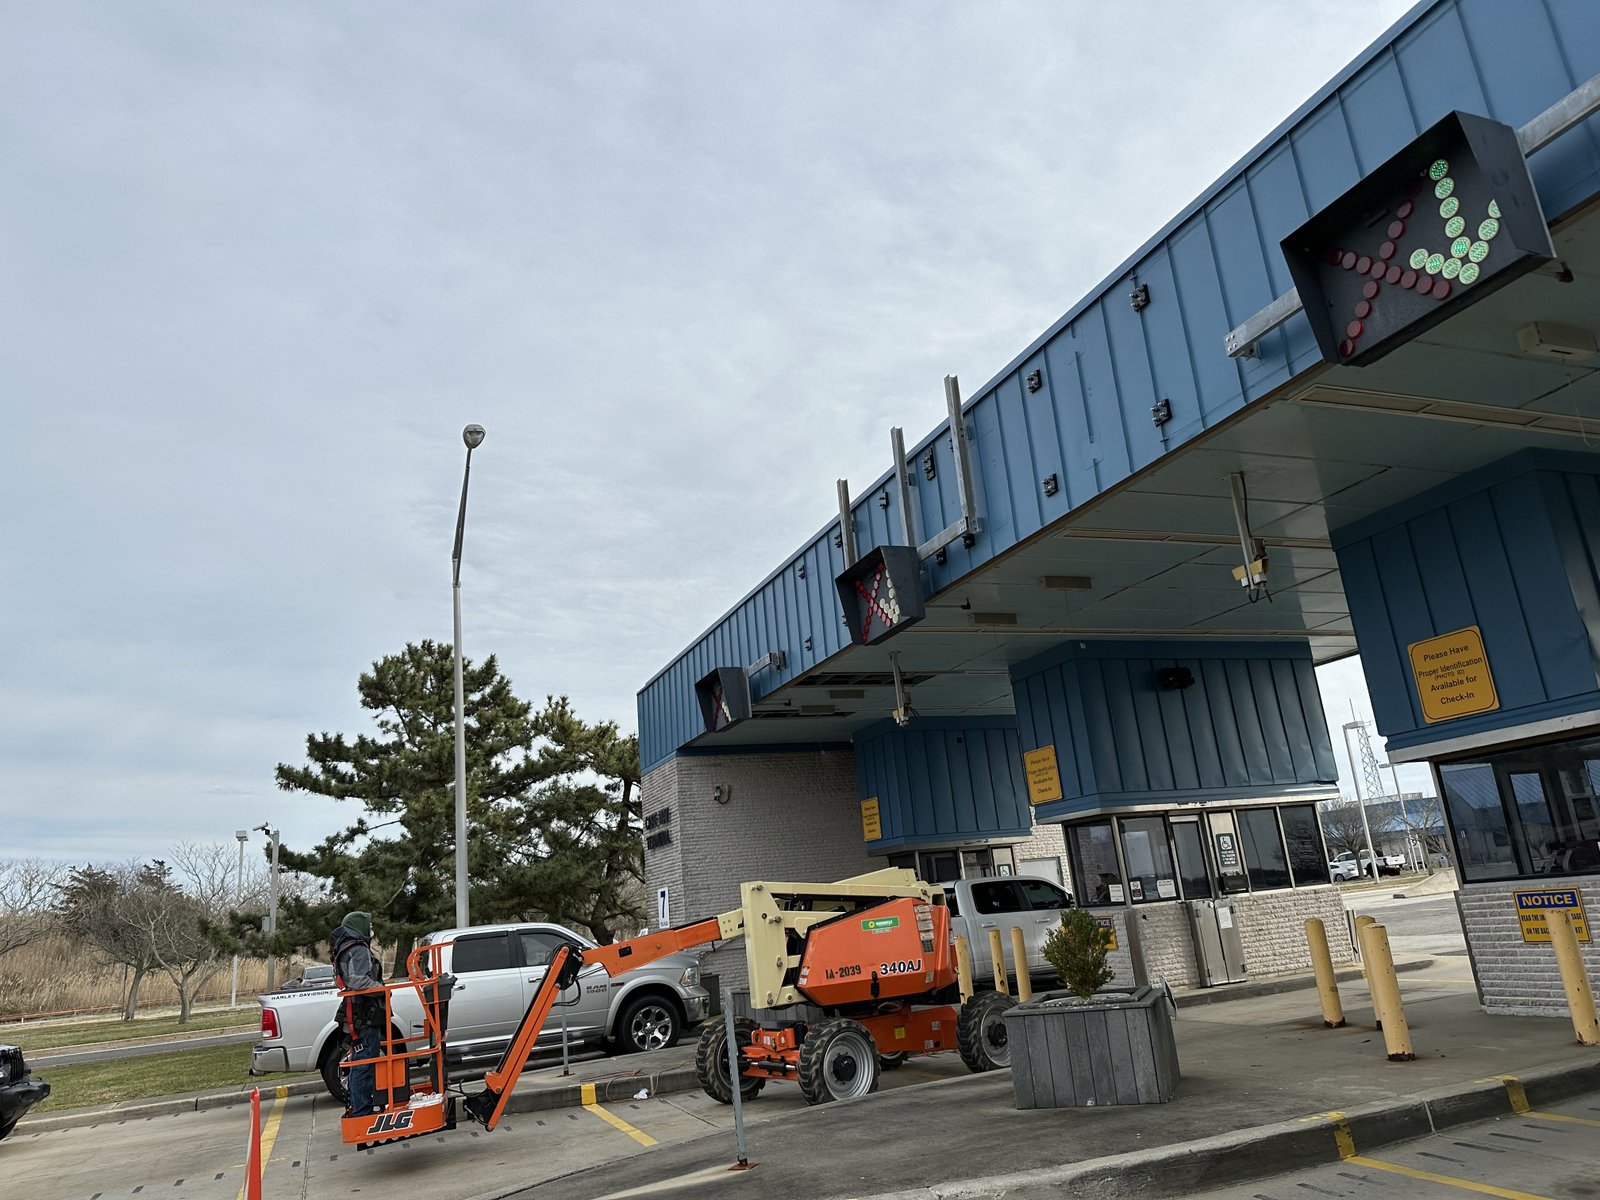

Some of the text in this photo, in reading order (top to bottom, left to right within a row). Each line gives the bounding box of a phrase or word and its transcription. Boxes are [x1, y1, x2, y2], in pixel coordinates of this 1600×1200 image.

[1423, 645, 1469, 661] Please Have
[1418, 657, 1483, 678] Proper Identification
[1430, 675, 1477, 692] Available for
[1440, 692, 1475, 705] Check-In
[660, 890, 666, 918] 7
[1521, 894, 1573, 906] NOTICE
[880, 960, 922, 975] 340AJ
[366, 1110, 414, 1135] JLG
